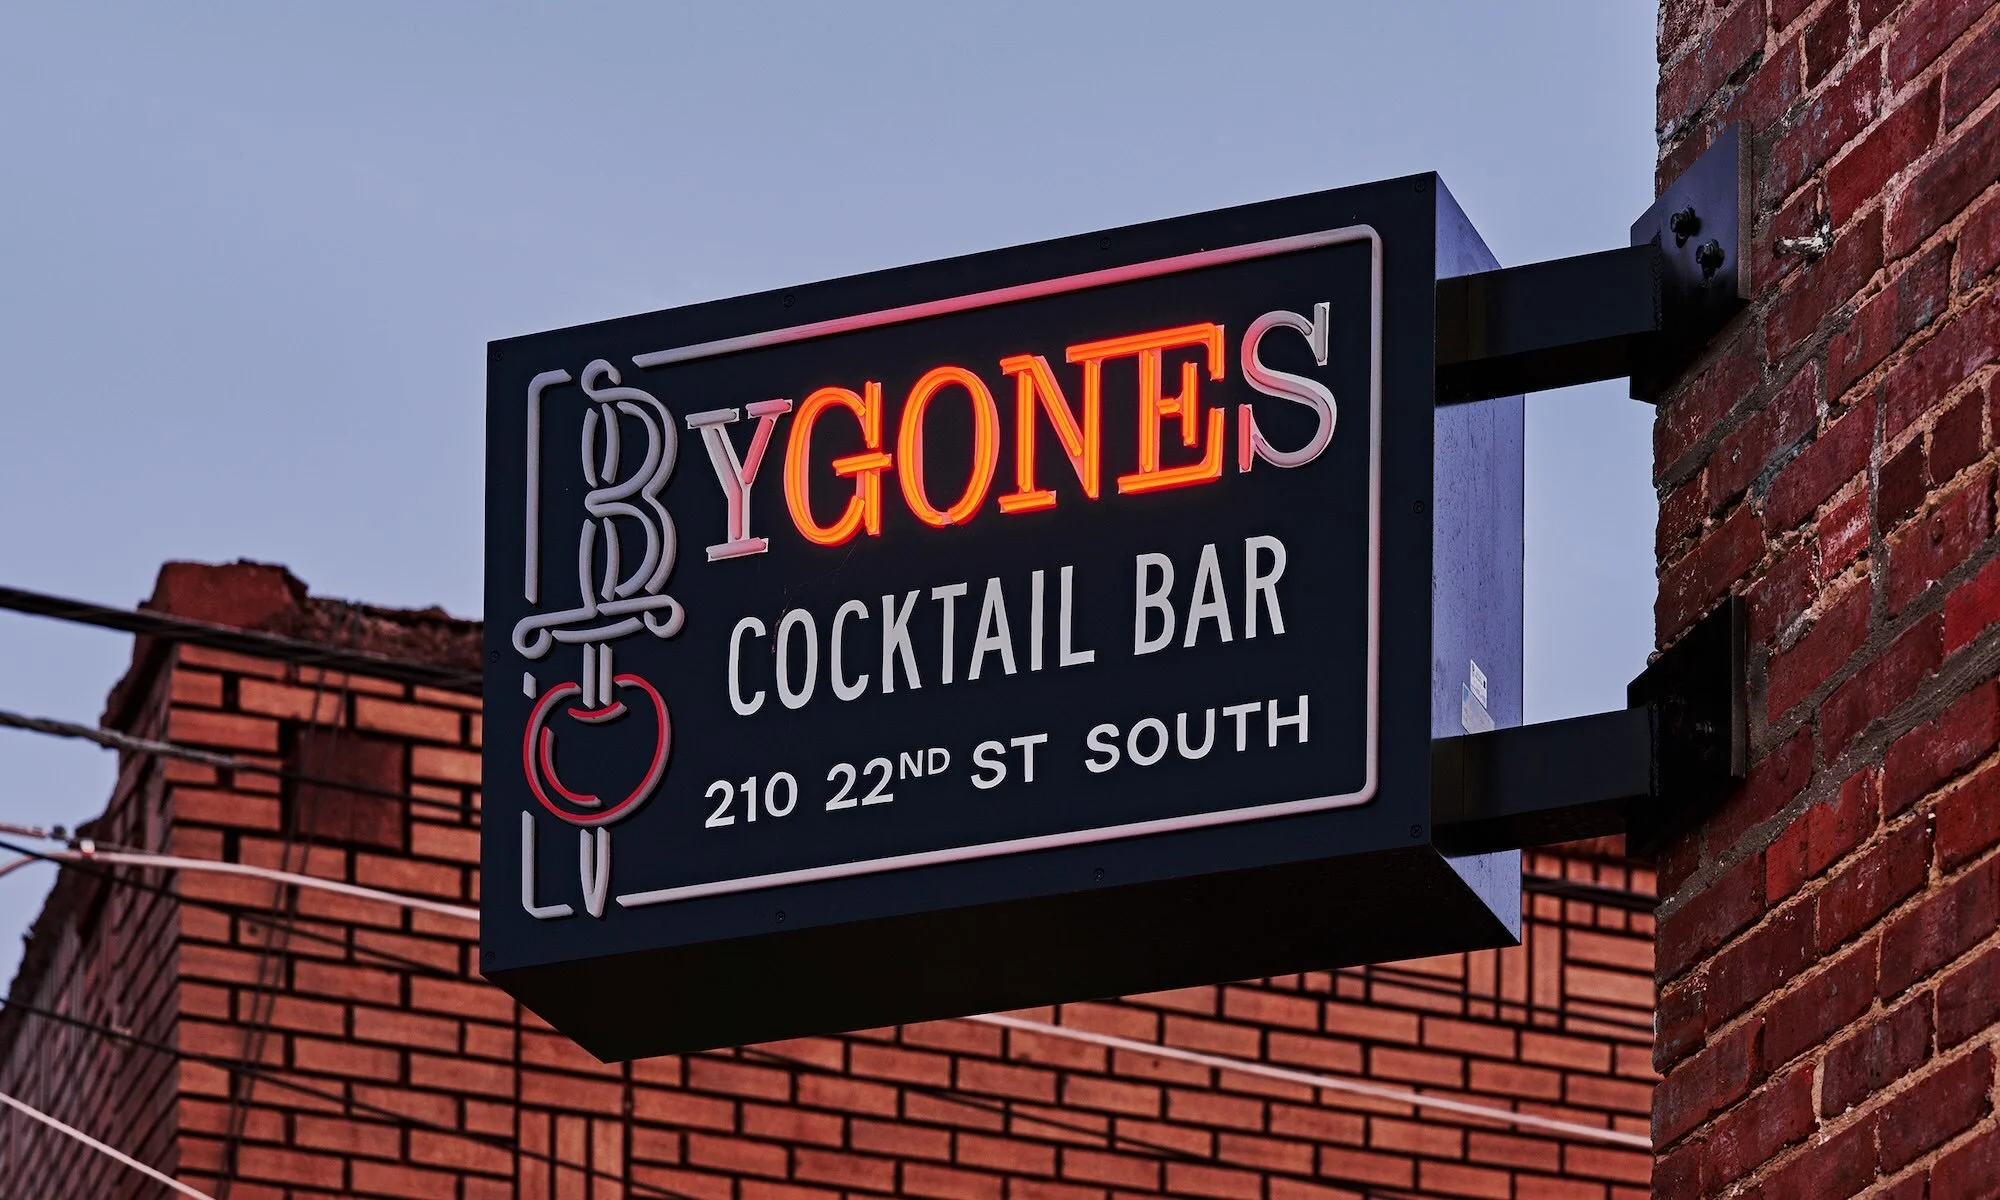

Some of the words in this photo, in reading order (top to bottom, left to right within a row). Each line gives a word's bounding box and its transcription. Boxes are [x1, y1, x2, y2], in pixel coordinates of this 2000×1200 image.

[580, 302, 1338, 606] BYGONES
[728, 566, 1096, 716] COCKTAIL
[1134, 535, 1287, 656] BAR
[704, 771, 798, 829] 210
[825, 747, 951, 812] 22ND
[970, 733, 1048, 790] ST
[1084, 694, 1309, 774] SOUTH
